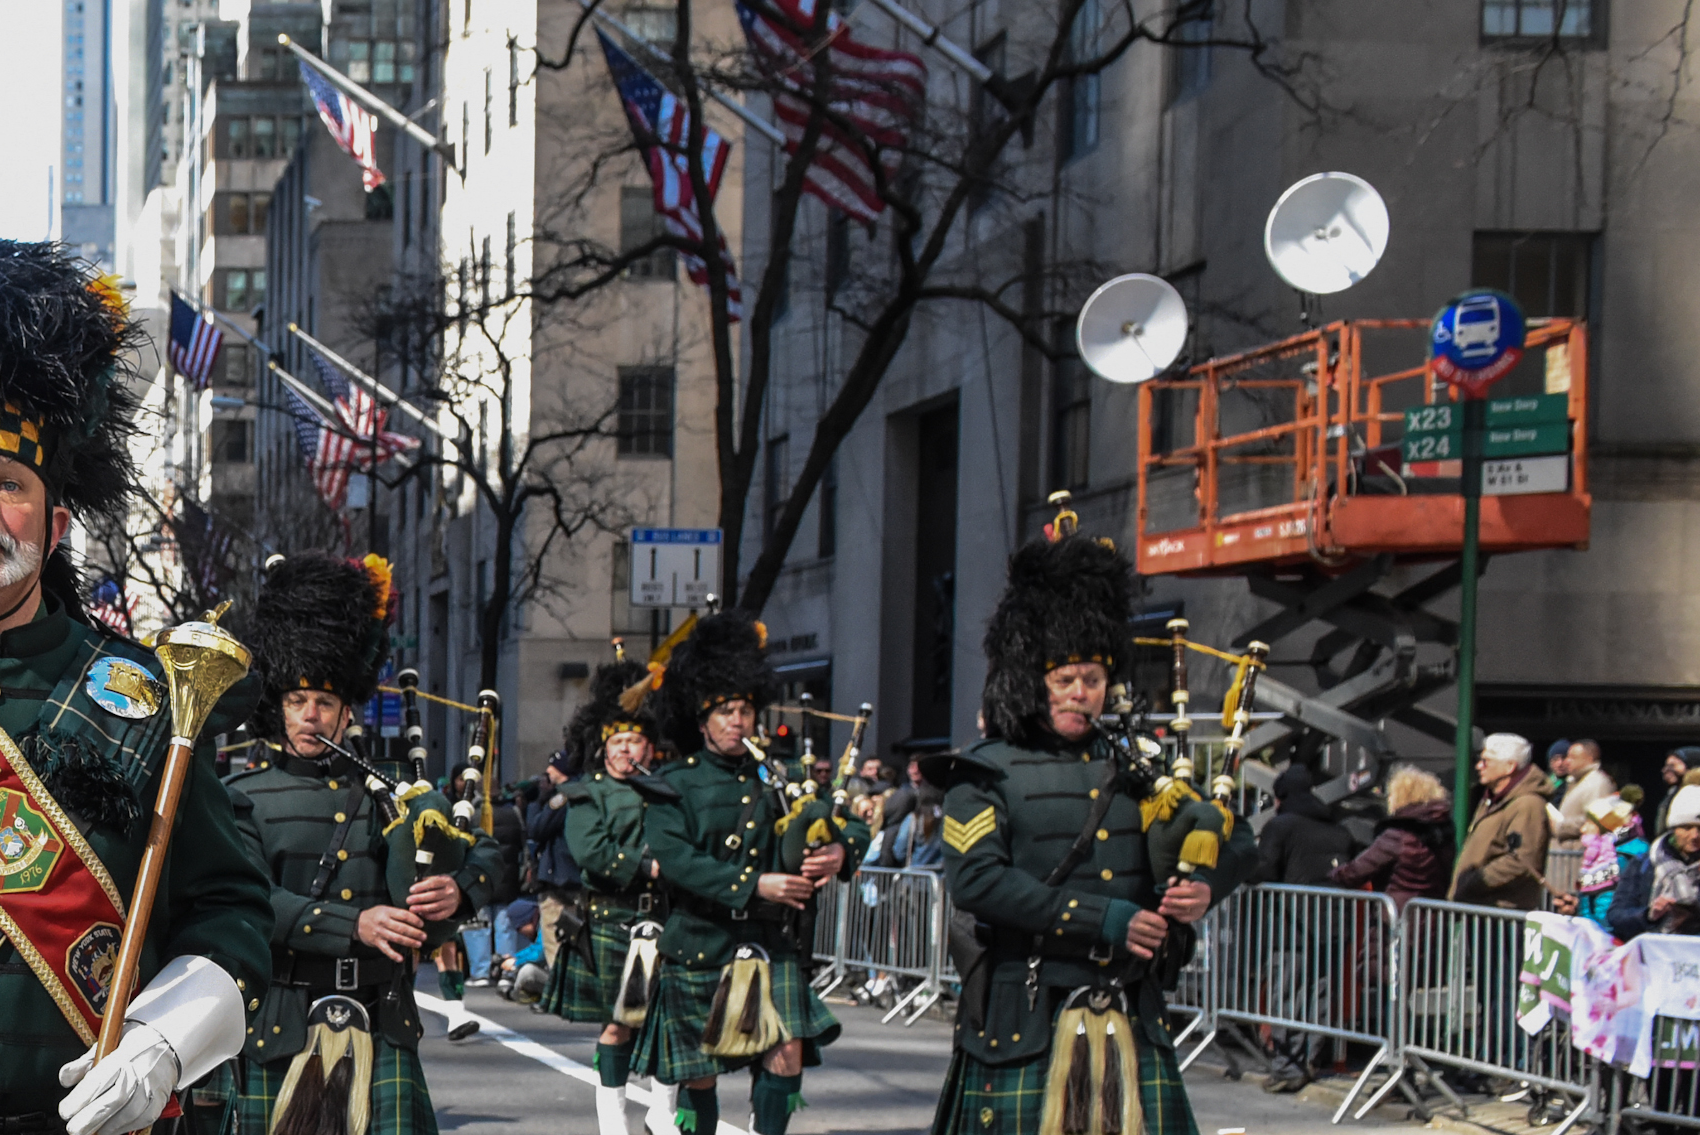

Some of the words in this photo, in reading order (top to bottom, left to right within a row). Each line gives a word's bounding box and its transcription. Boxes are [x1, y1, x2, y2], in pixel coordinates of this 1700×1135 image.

[20, 863, 43, 885] 1976
[71, 948, 82, 974] NEW
[79, 932, 95, 950] YORK
[93, 928, 113, 938] STATE
